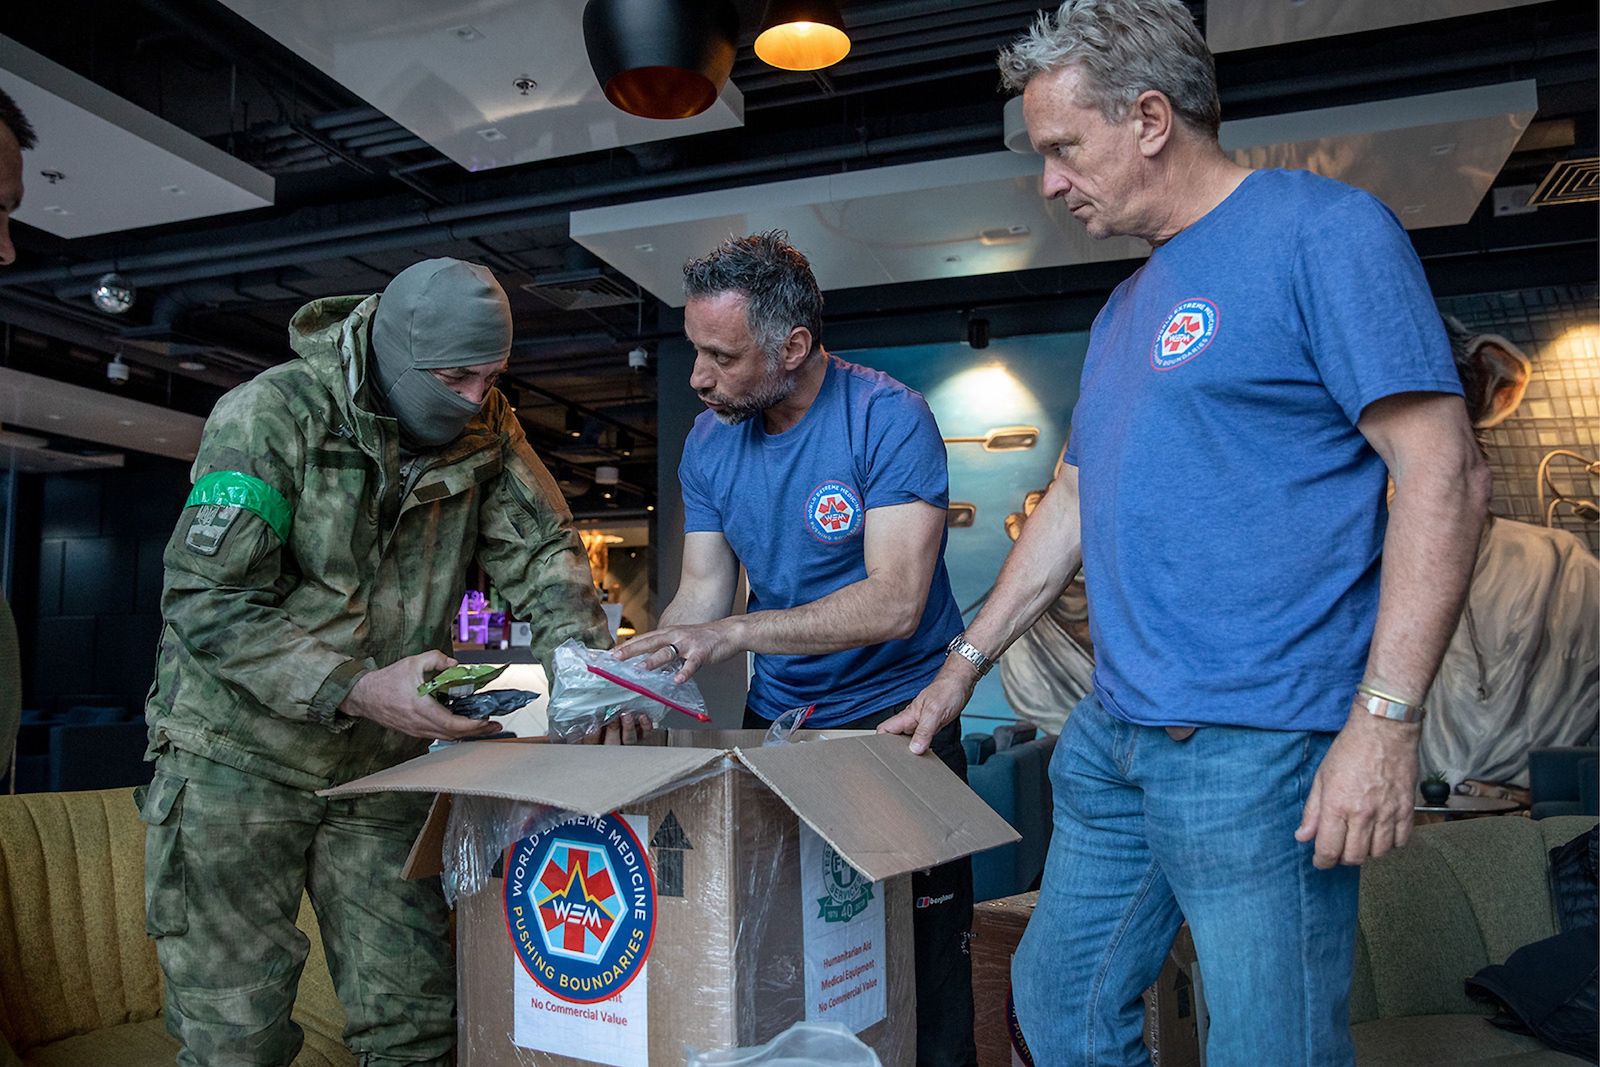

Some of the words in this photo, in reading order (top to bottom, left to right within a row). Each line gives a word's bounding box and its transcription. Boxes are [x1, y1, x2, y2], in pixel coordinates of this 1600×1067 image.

[816, 484, 840, 497] EXTREME
[840, 487, 861, 513] MEDICINE
[513, 834, 540, 897] WORLD
[608, 829, 646, 921] MEDICINE
[552, 899, 602, 929] WEM
[513, 906, 555, 980] PUSHING
[559, 928, 644, 991] BOUNDARIES
[823, 946, 862, 968] Humanitarian
[862, 939, 872, 952] Aid
[821, 970, 845, 991] Medical
[845, 959, 875, 979] Equipment
[818, 1002, 828, 1013] No
[829, 984, 862, 1008] Commercial
[862, 978, 878, 992] Value
[531, 998, 543, 1010] No
[545, 1000, 599, 1021] Commercial
[600, 1011, 628, 1026] Value
